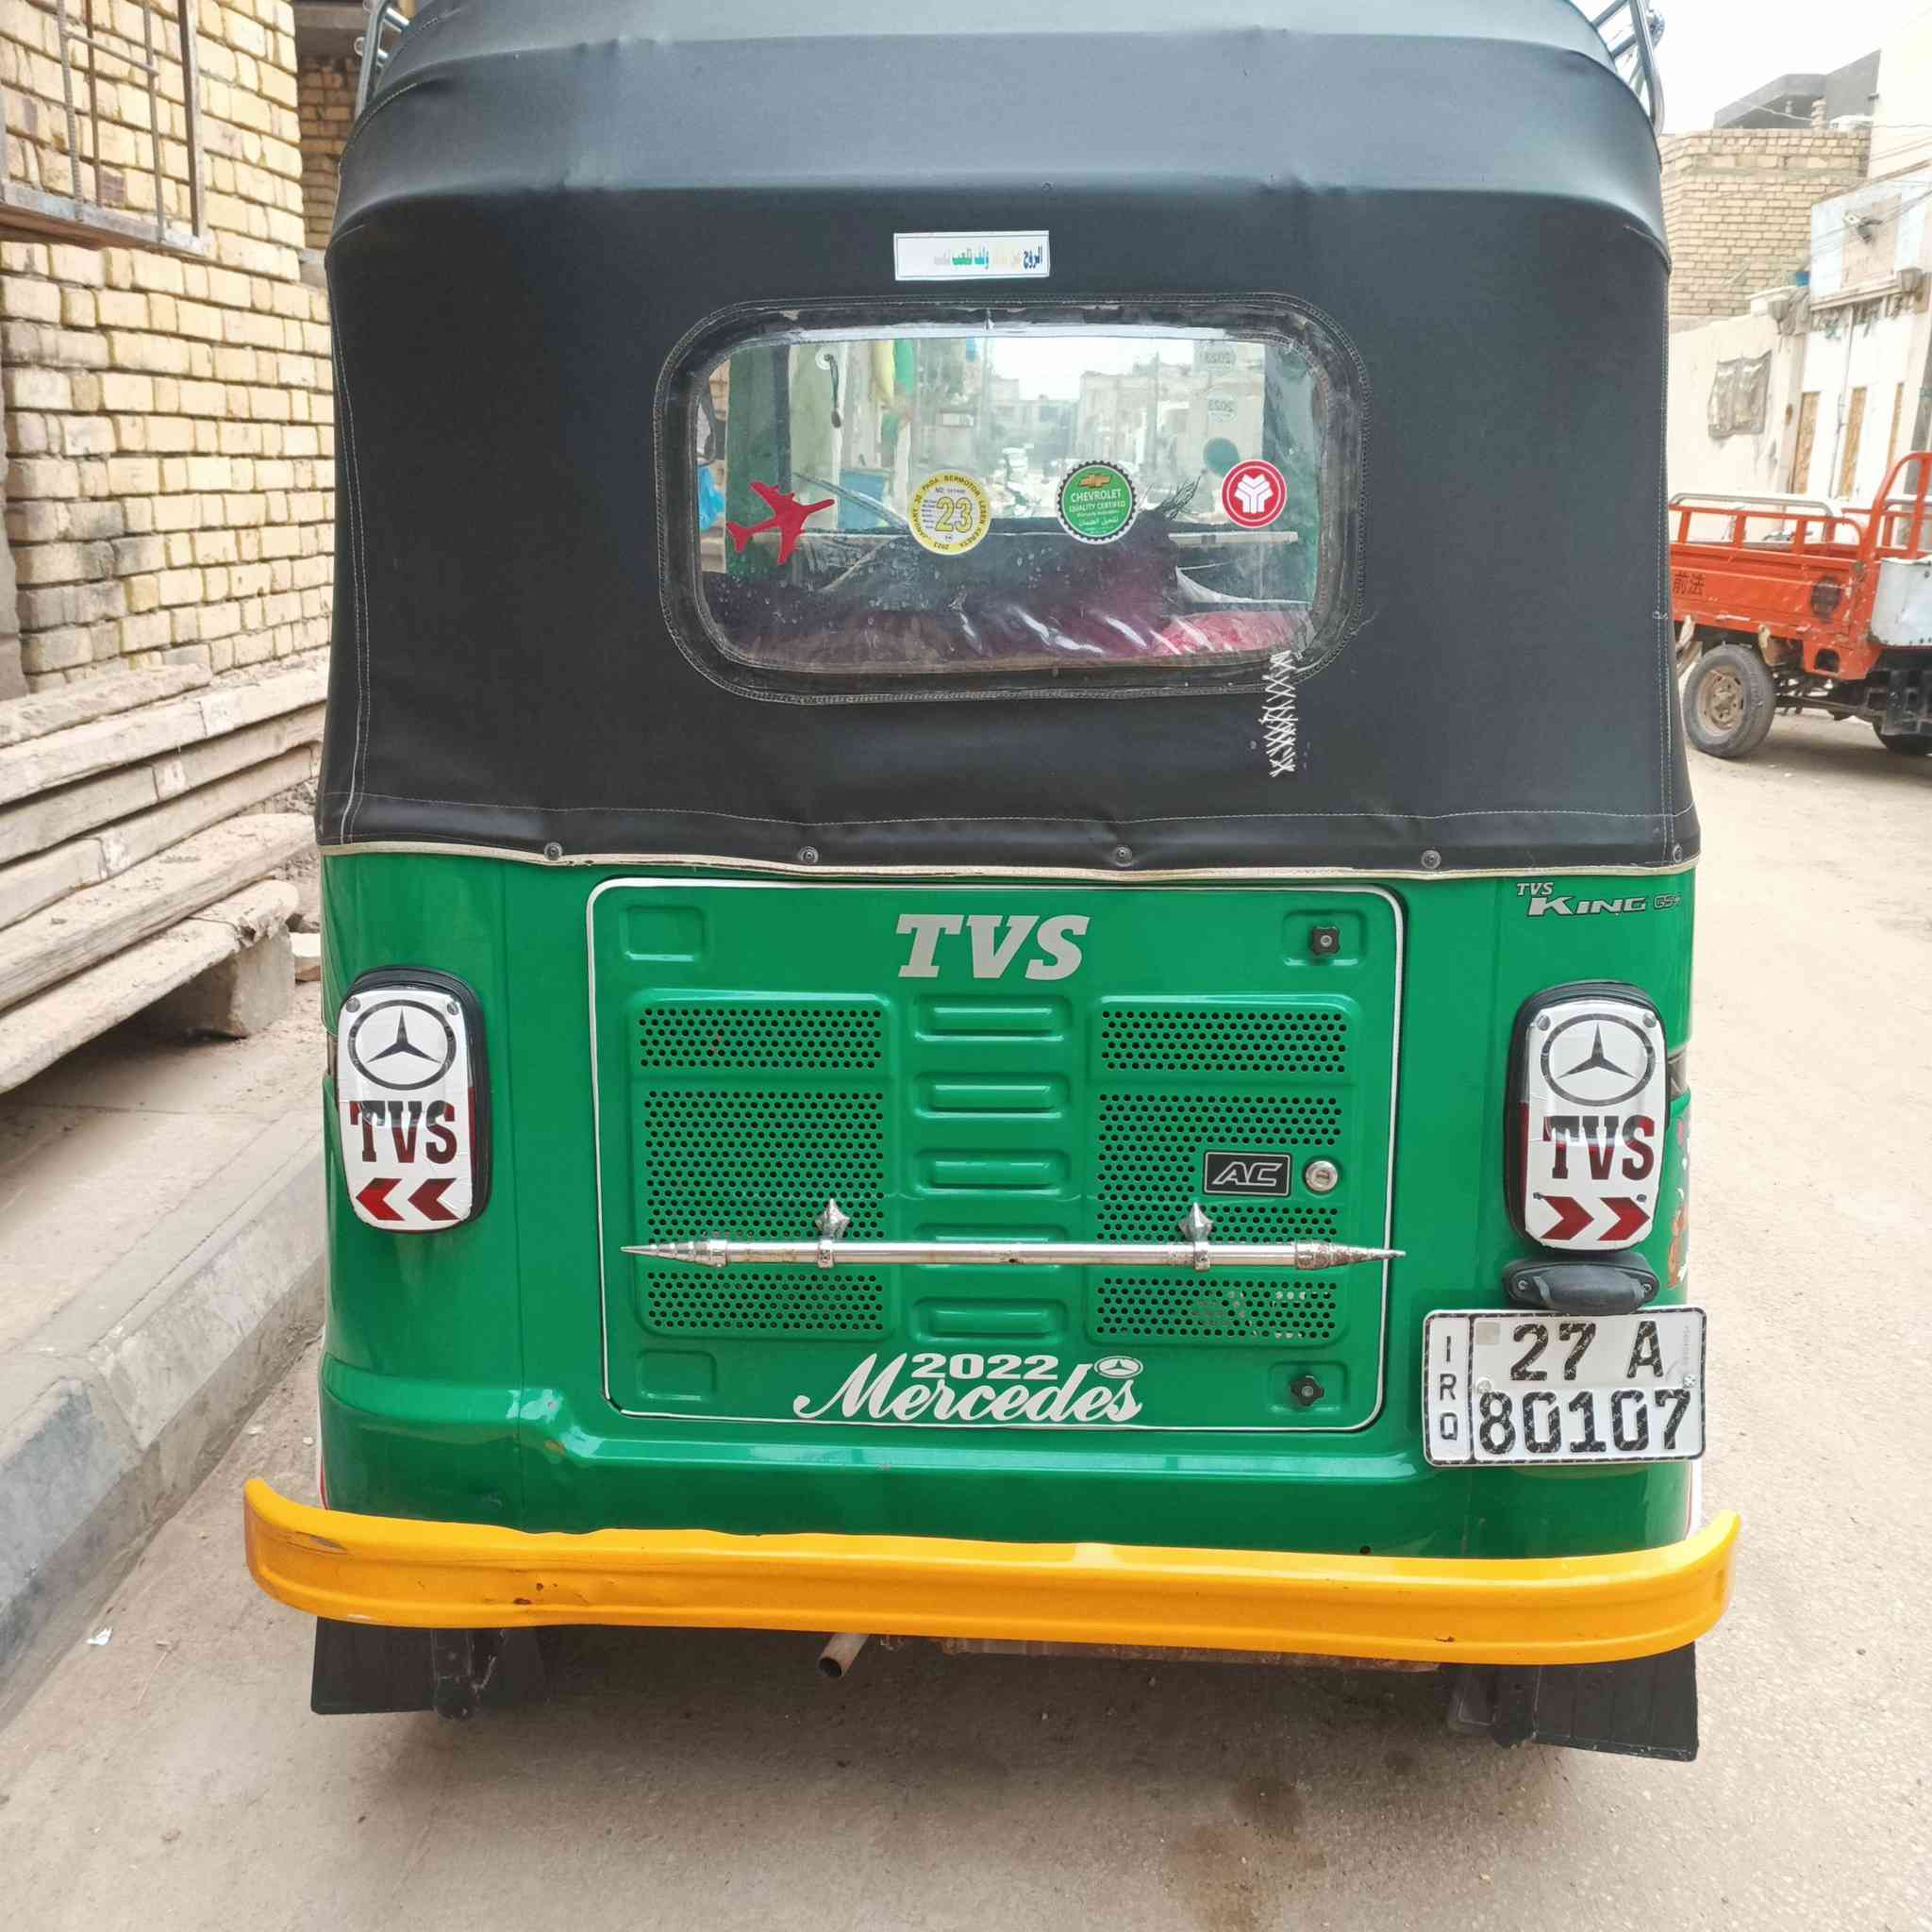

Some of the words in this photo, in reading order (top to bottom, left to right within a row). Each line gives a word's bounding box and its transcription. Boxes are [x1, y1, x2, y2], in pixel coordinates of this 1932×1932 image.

[935, 496, 973, 533] 23
[1071, 489, 1121, 503] CHEVROLET
[1516, 882, 1554, 896] TVS
[896, 913, 1091, 981] TVS
[349, 1100, 458, 1164] TVS
[1543, 1114, 1656, 1180] TVS
[1211, 1161, 1284, 1187] AC
[910, 1353, 1059, 1380] 2022
[1509, 1322, 1596, 1382] 27
[1626, 1320, 1664, 1378] A
[792, 1352, 1143, 1422] Mercedes
[1478, 1389, 1691, 1455] 80107
